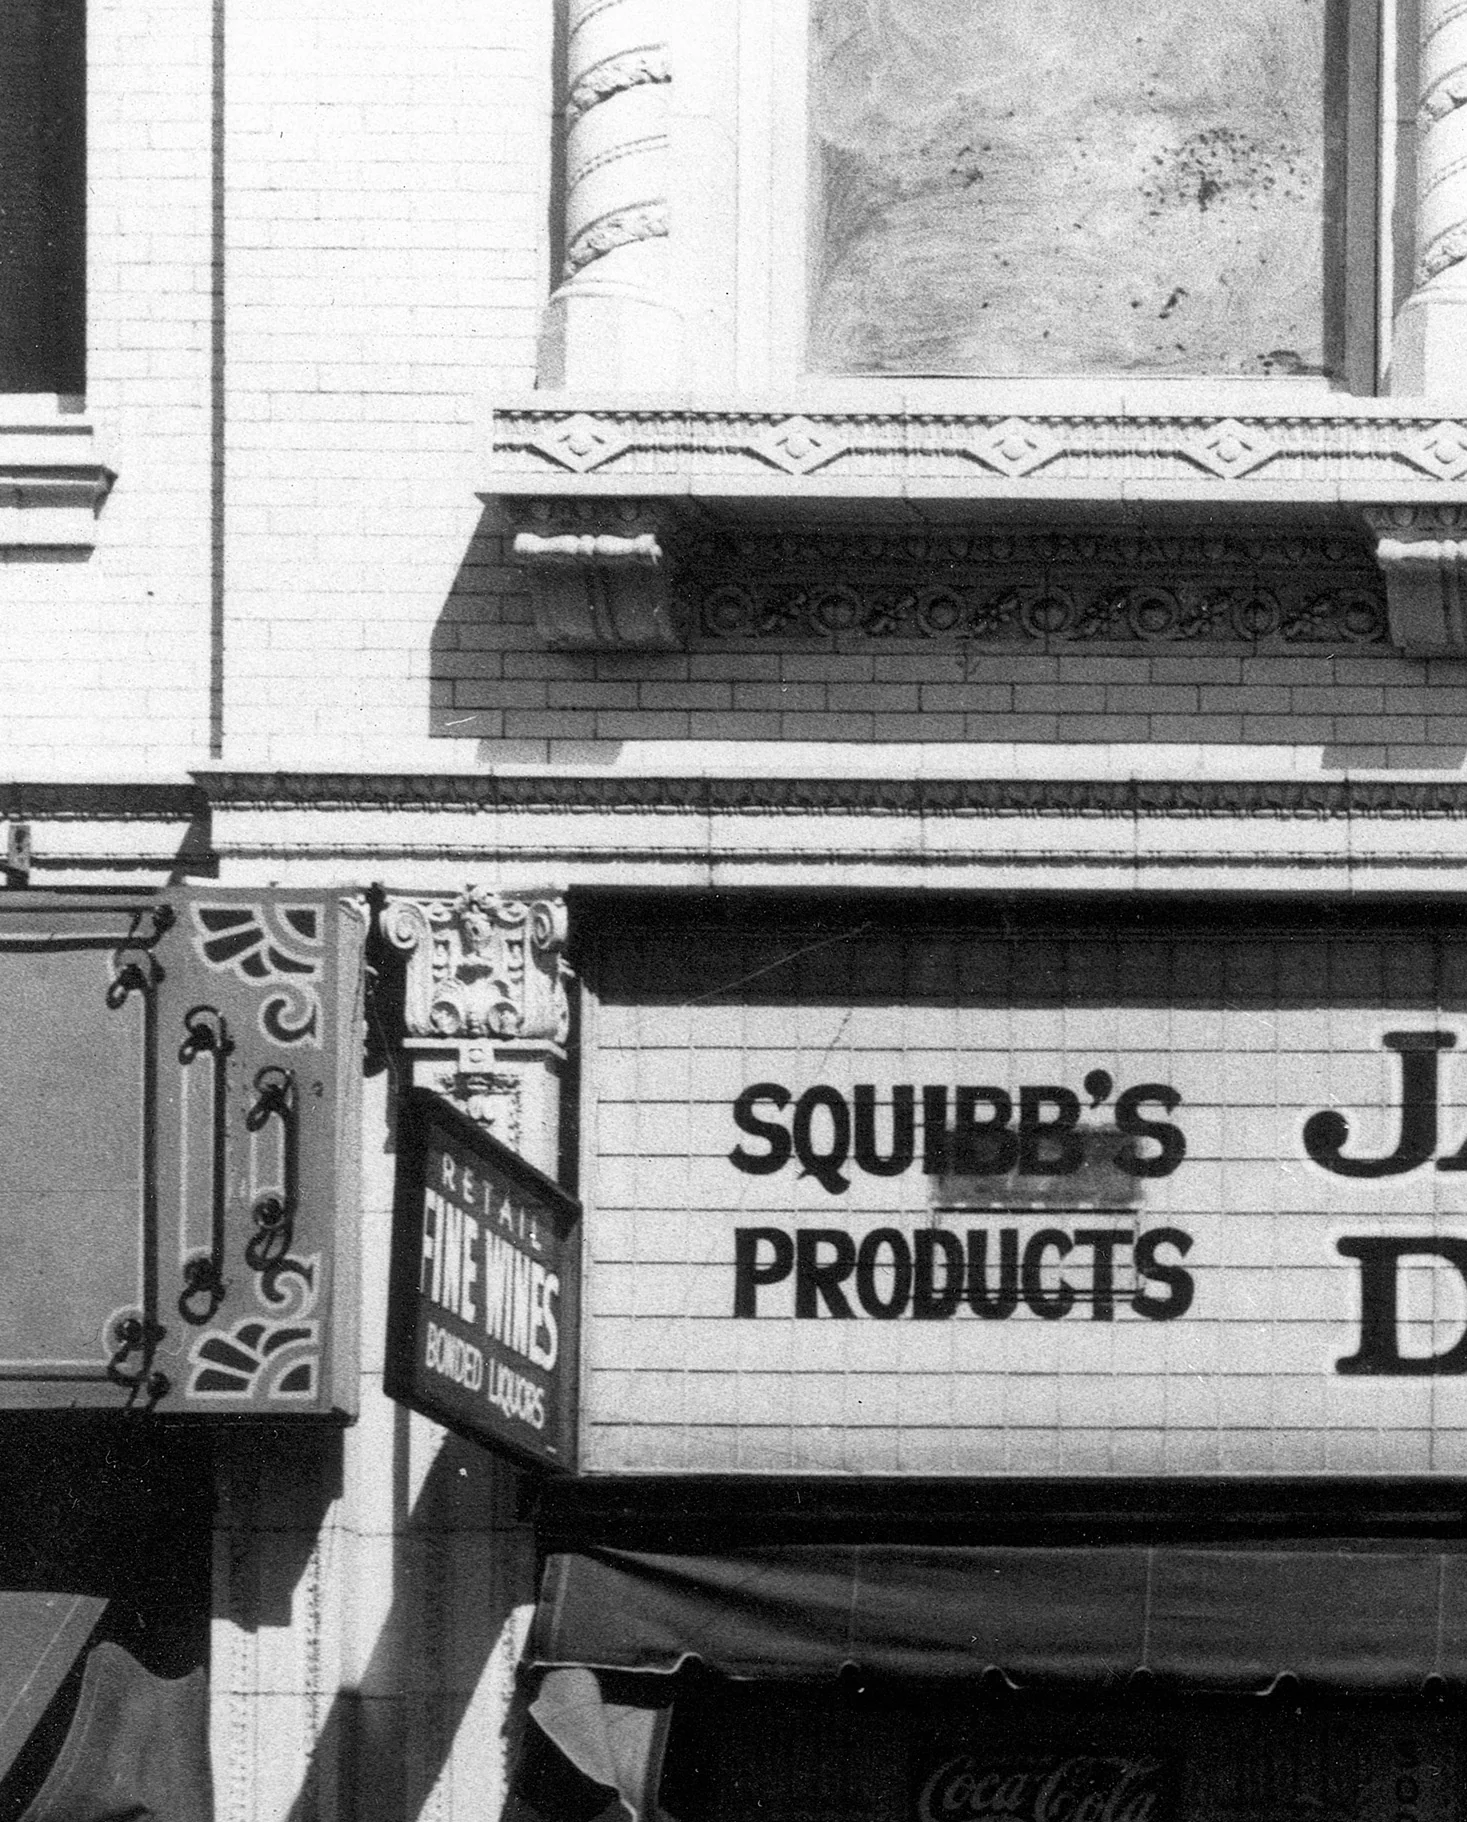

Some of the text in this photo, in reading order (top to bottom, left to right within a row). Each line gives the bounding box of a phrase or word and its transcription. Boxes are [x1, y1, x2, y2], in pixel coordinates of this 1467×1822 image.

[728, 1068, 1188, 1196] SQUIBB'S
[442, 1152, 541, 1251] RETAIL
[485, 1228, 560, 1371] WINES
[734, 1226, 1195, 1322] PRODUCTS
